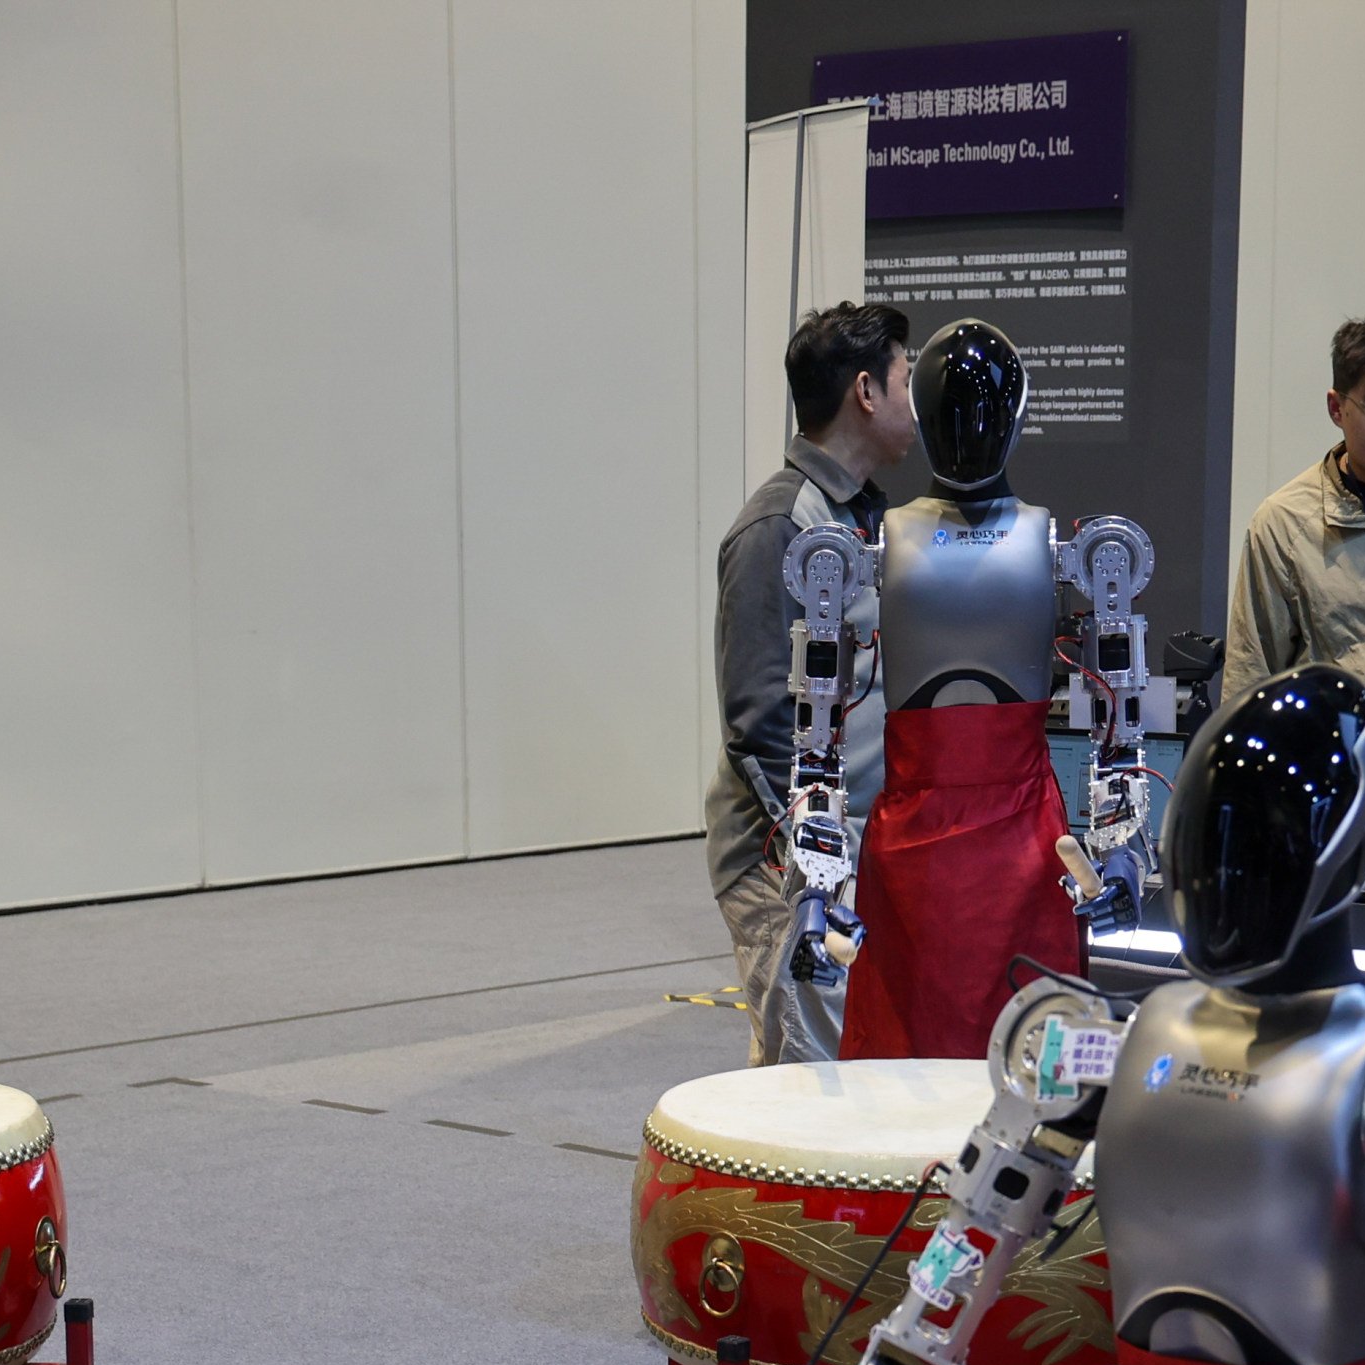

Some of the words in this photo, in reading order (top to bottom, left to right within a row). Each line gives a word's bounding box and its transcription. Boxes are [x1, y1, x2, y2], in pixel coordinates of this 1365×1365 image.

[867, 152, 887, 168] hai
[890, 146, 940, 168] MScape
[942, 141, 1016, 164] Technology
[1019, 138, 1046, 160] Co.,
[1049, 136, 1074, 156] Ltd.
